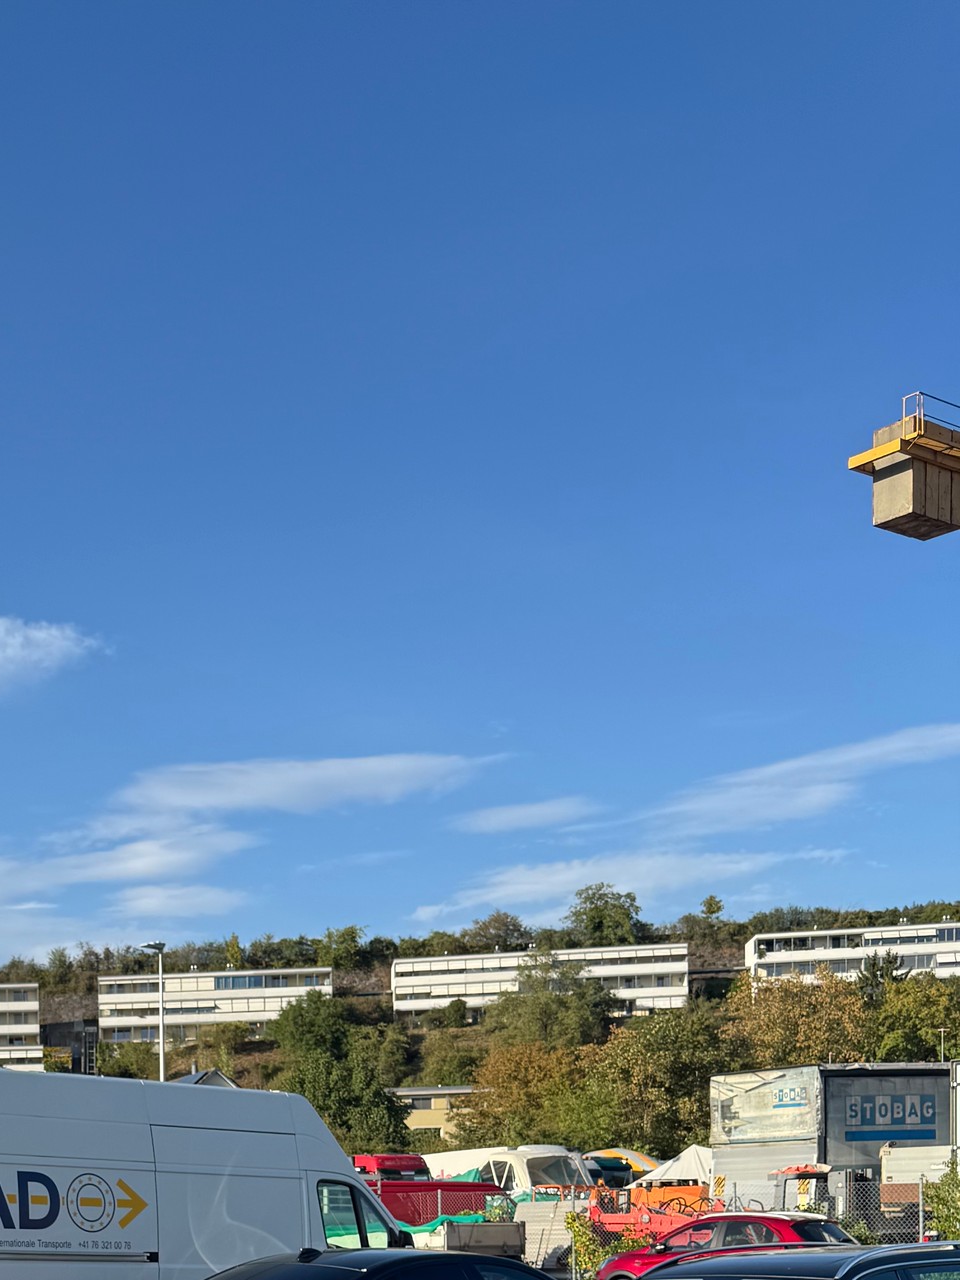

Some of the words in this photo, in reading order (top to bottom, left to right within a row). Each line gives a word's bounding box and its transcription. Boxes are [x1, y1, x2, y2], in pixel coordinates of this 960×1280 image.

[773, 1088, 807, 1101] STOBAG
[848, 1100, 934, 1119] STOBAG
[37, 1239, 72, 1250] Transporte
[78, 1240, 89, 1249] +41
[91, 1240, 99, 1249] 76
[101, 1240, 113, 1250] 321
[114, 1241, 123, 1250] 00
